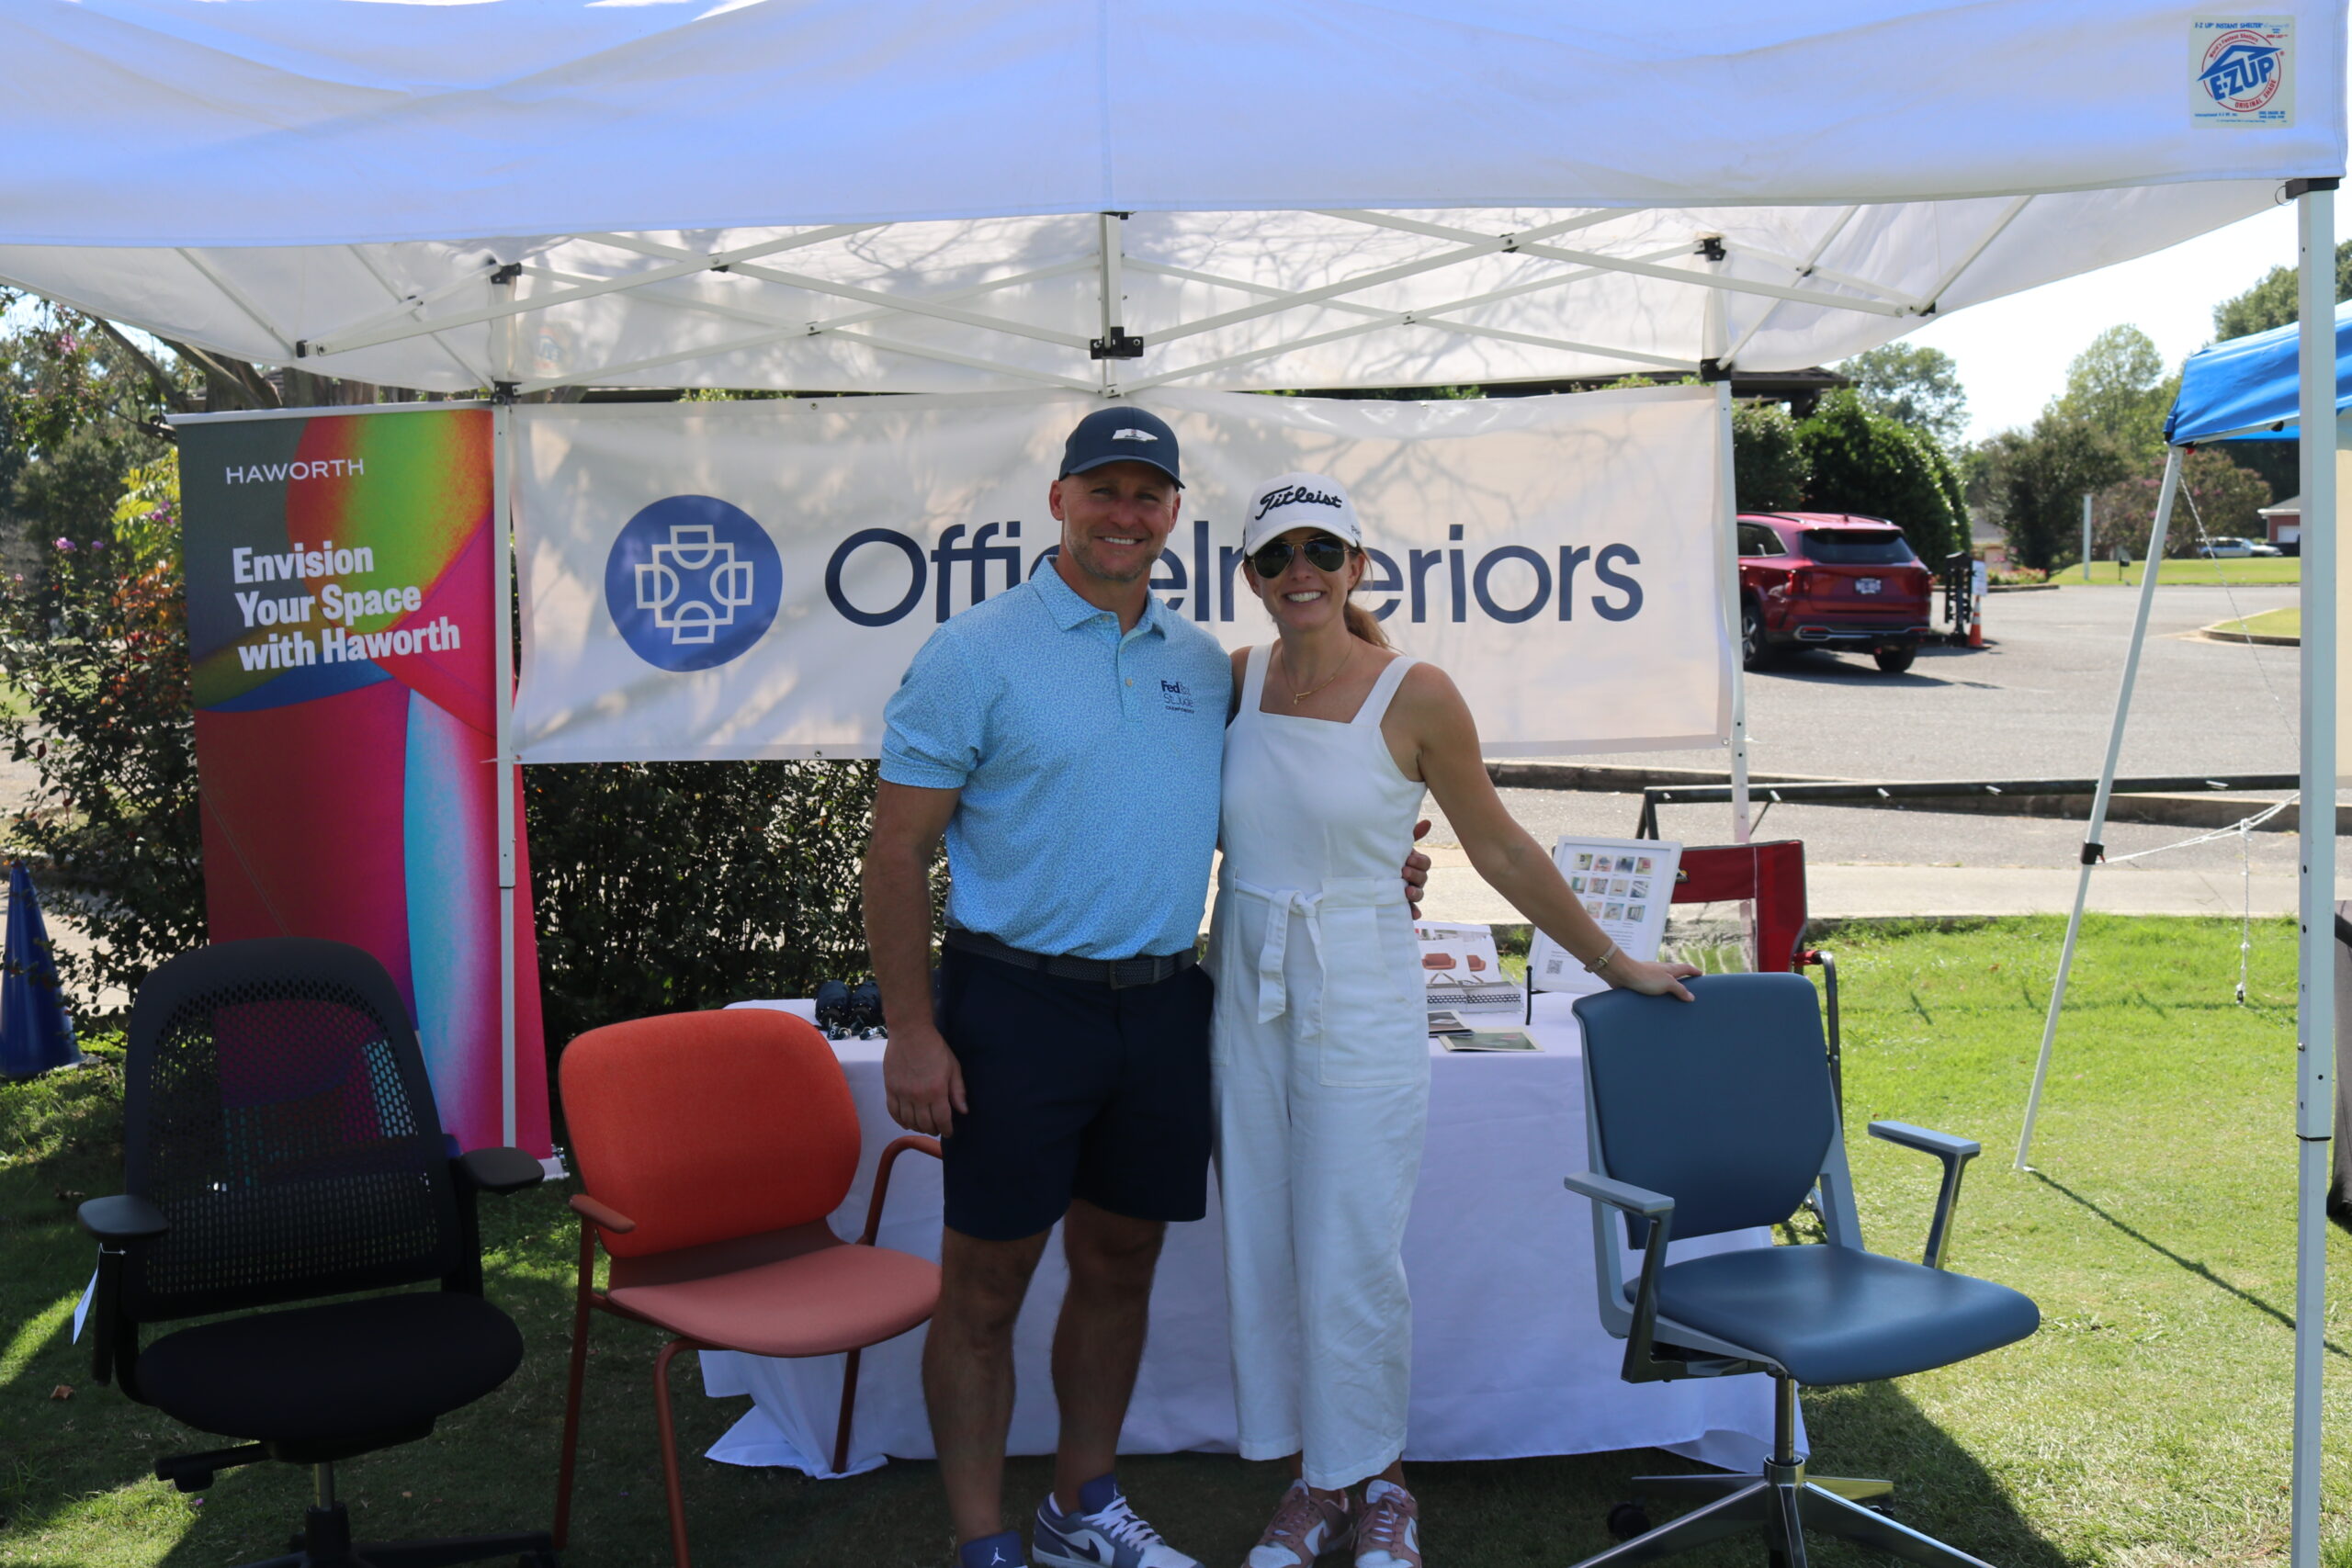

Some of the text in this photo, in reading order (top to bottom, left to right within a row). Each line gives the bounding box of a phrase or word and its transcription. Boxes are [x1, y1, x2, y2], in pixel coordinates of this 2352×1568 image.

[2234, 79, 2277, 108] ORIGINAL SHADE
[226, 458, 365, 485] HAWORTH
[1255, 485, 1342, 520] Titleist
[232, 540, 375, 584] Envision
[235, 584, 422, 628] Your Space
[238, 616, 461, 671] with Haworth
